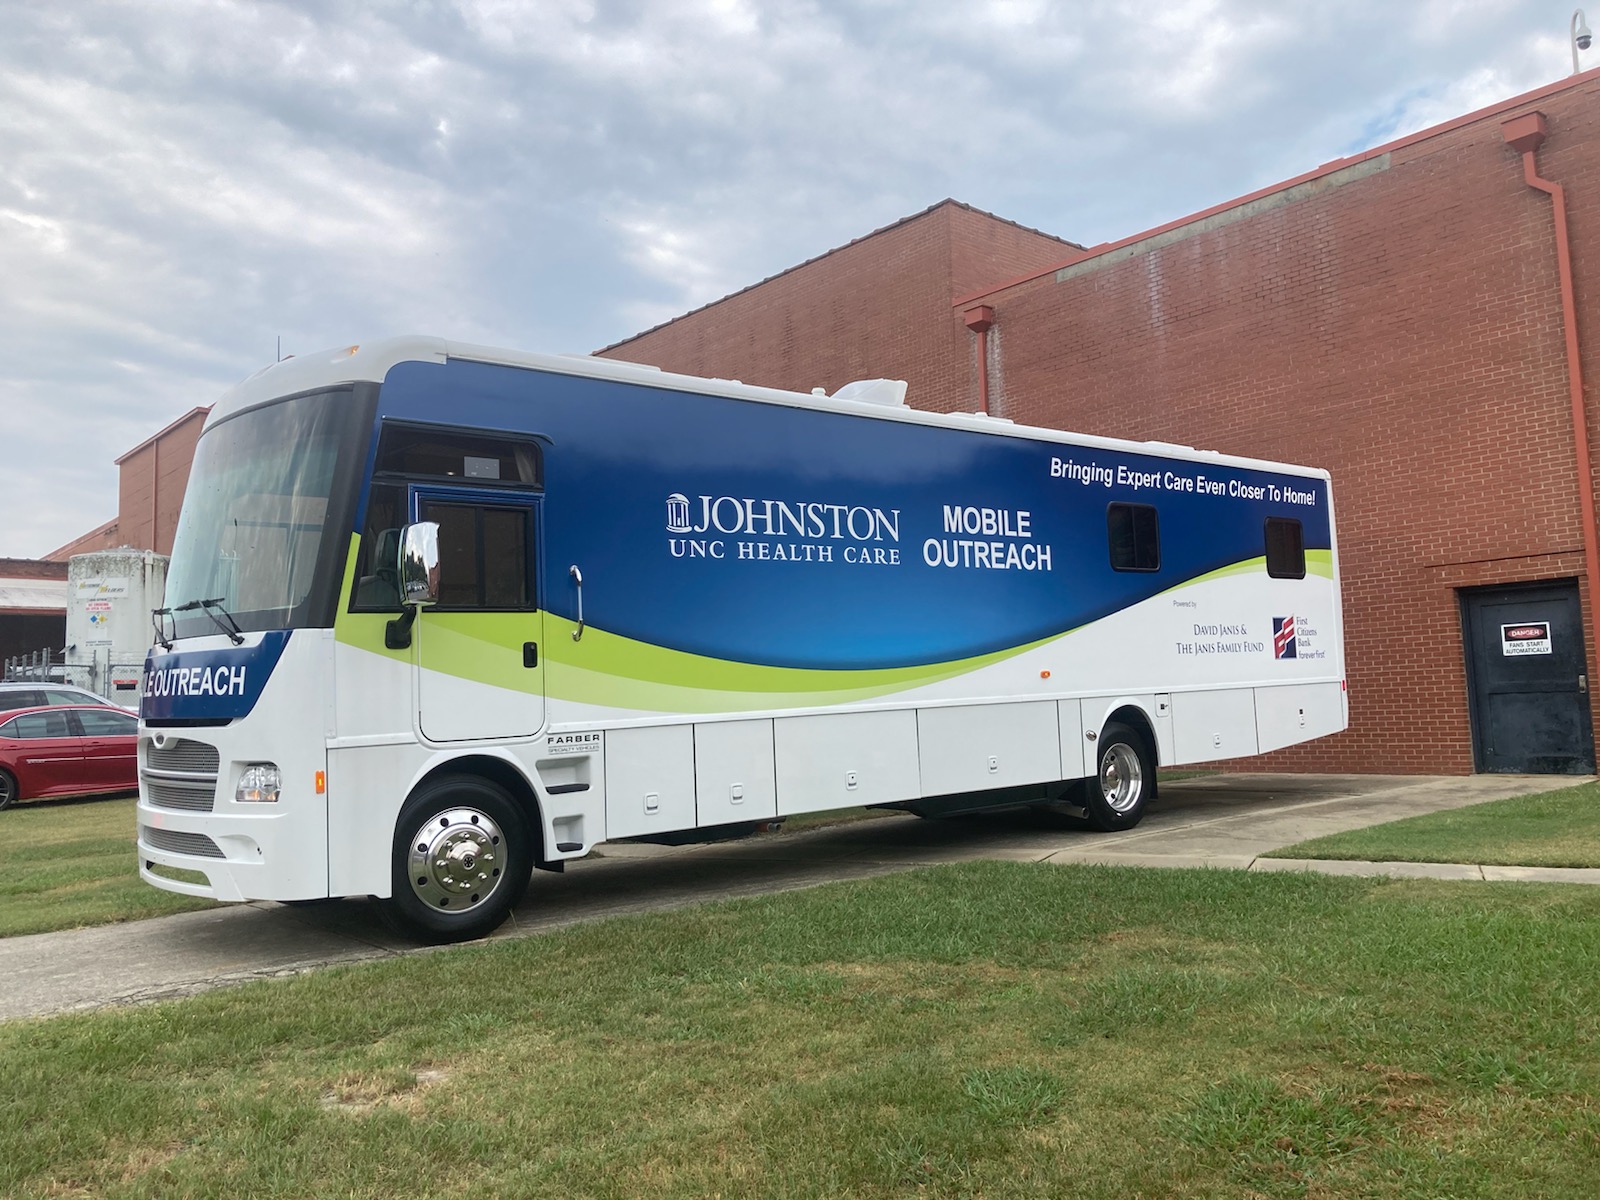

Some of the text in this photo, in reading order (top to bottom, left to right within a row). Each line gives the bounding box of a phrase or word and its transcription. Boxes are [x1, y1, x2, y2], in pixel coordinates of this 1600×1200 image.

[1050, 457, 1317, 506] Bringing Expert Care Even Closer To Home!
[695, 495, 901, 543] JOHNSTON
[942, 504, 1032, 538] MOBILE
[668, 538, 901, 566] UNC HEALTH CARE
[922, 538, 1053, 571] OUTREACH
[1173, 600, 1191, 608] Powered
[1296, 616, 1308, 625] First
[1193, 623, 1247, 637] DAVID JANIS &
[1297, 627, 1317, 637] Citizens
[1176, 641, 1265, 656] THE JANIS FAMILY FUND
[1298, 637, 1311, 647] Bank
[154, 666, 246, 697] OUTREACH
[547, 734, 600, 744] FARBER
